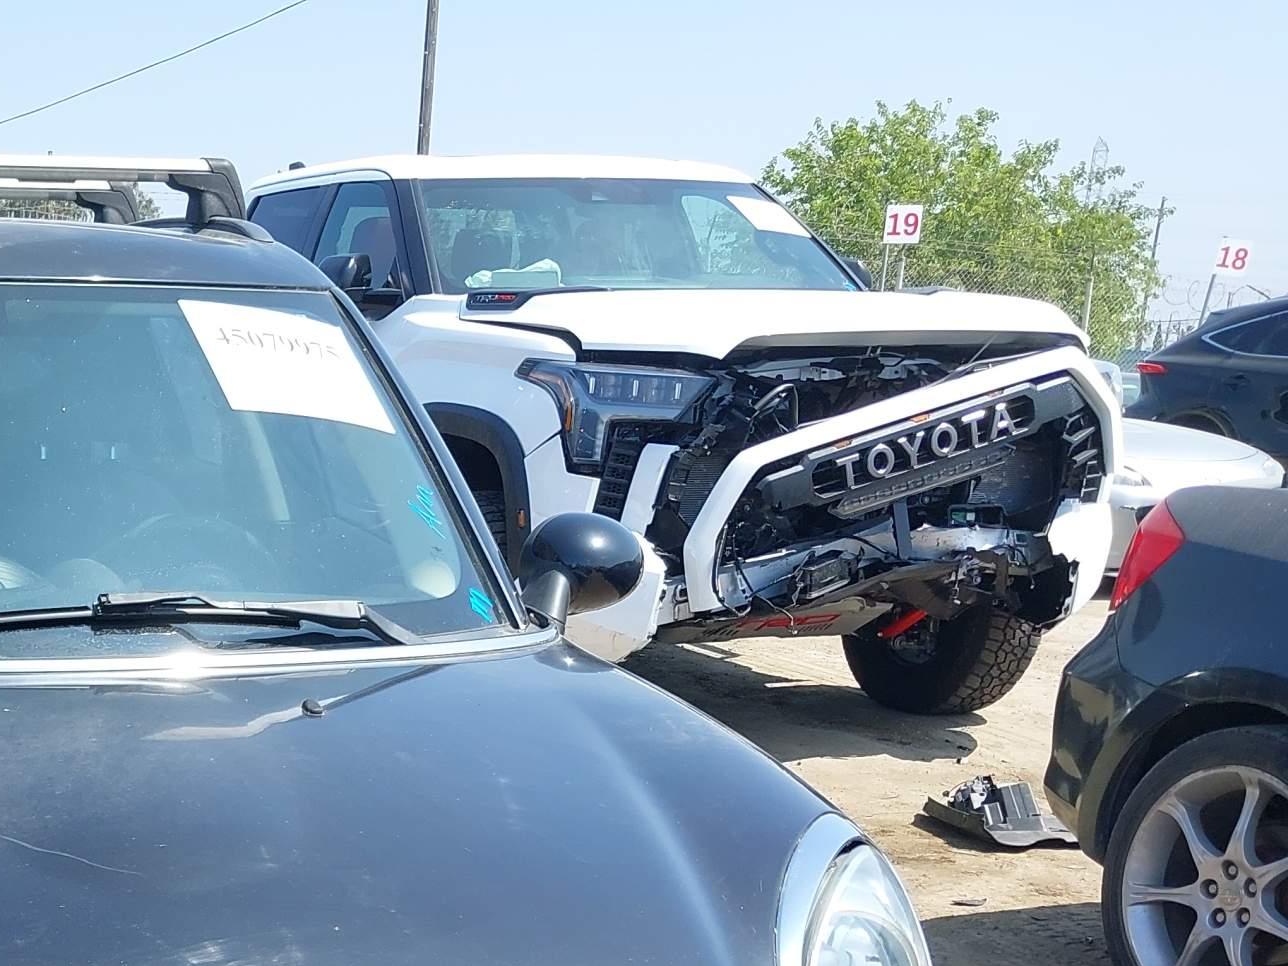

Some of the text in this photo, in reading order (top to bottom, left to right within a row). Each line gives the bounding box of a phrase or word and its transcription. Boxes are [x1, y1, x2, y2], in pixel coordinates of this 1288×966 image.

[886, 212, 919, 236] 19
[1215, 246, 1248, 270] 18
[835, 402, 1017, 490] TOYOTA
